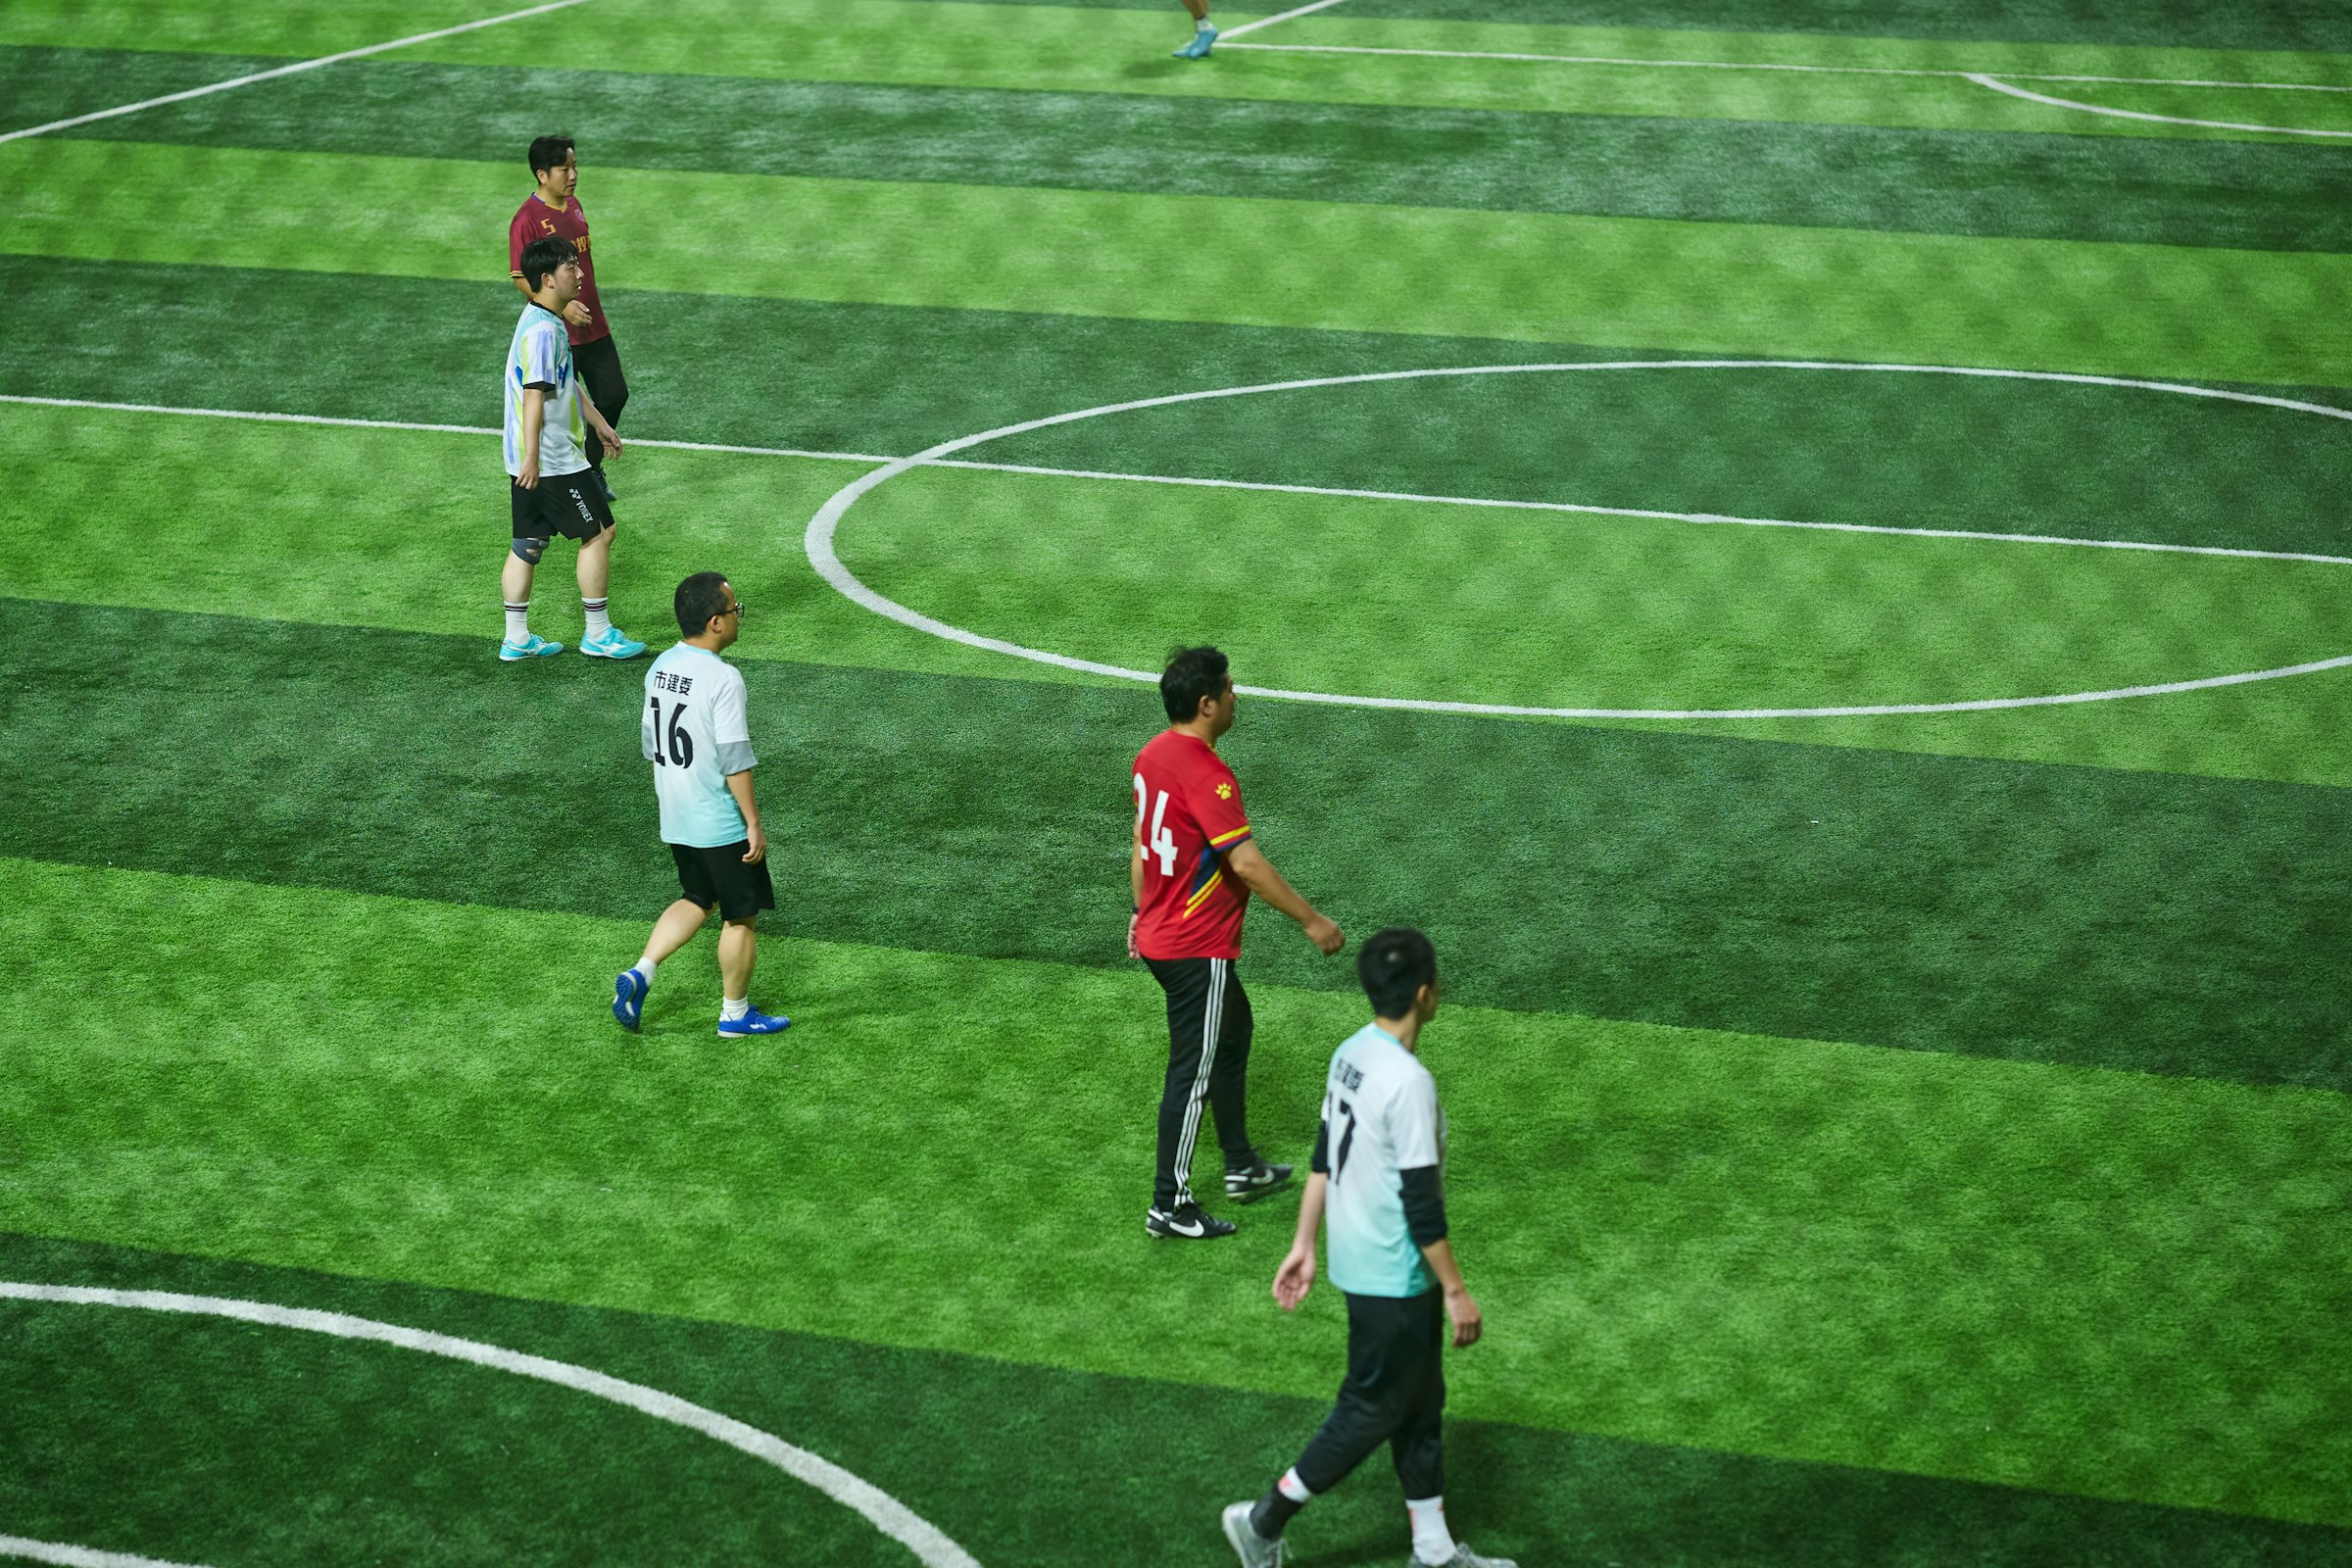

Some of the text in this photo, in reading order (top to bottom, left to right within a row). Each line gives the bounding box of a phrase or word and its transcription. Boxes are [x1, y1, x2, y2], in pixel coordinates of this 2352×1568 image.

[540, 218, 557, 236] 5
[575, 499, 594, 523] YONEX
[653, 670, 694, 697] 市建委
[650, 696, 694, 769] 16
[1327, 1091, 1357, 1187] 7
